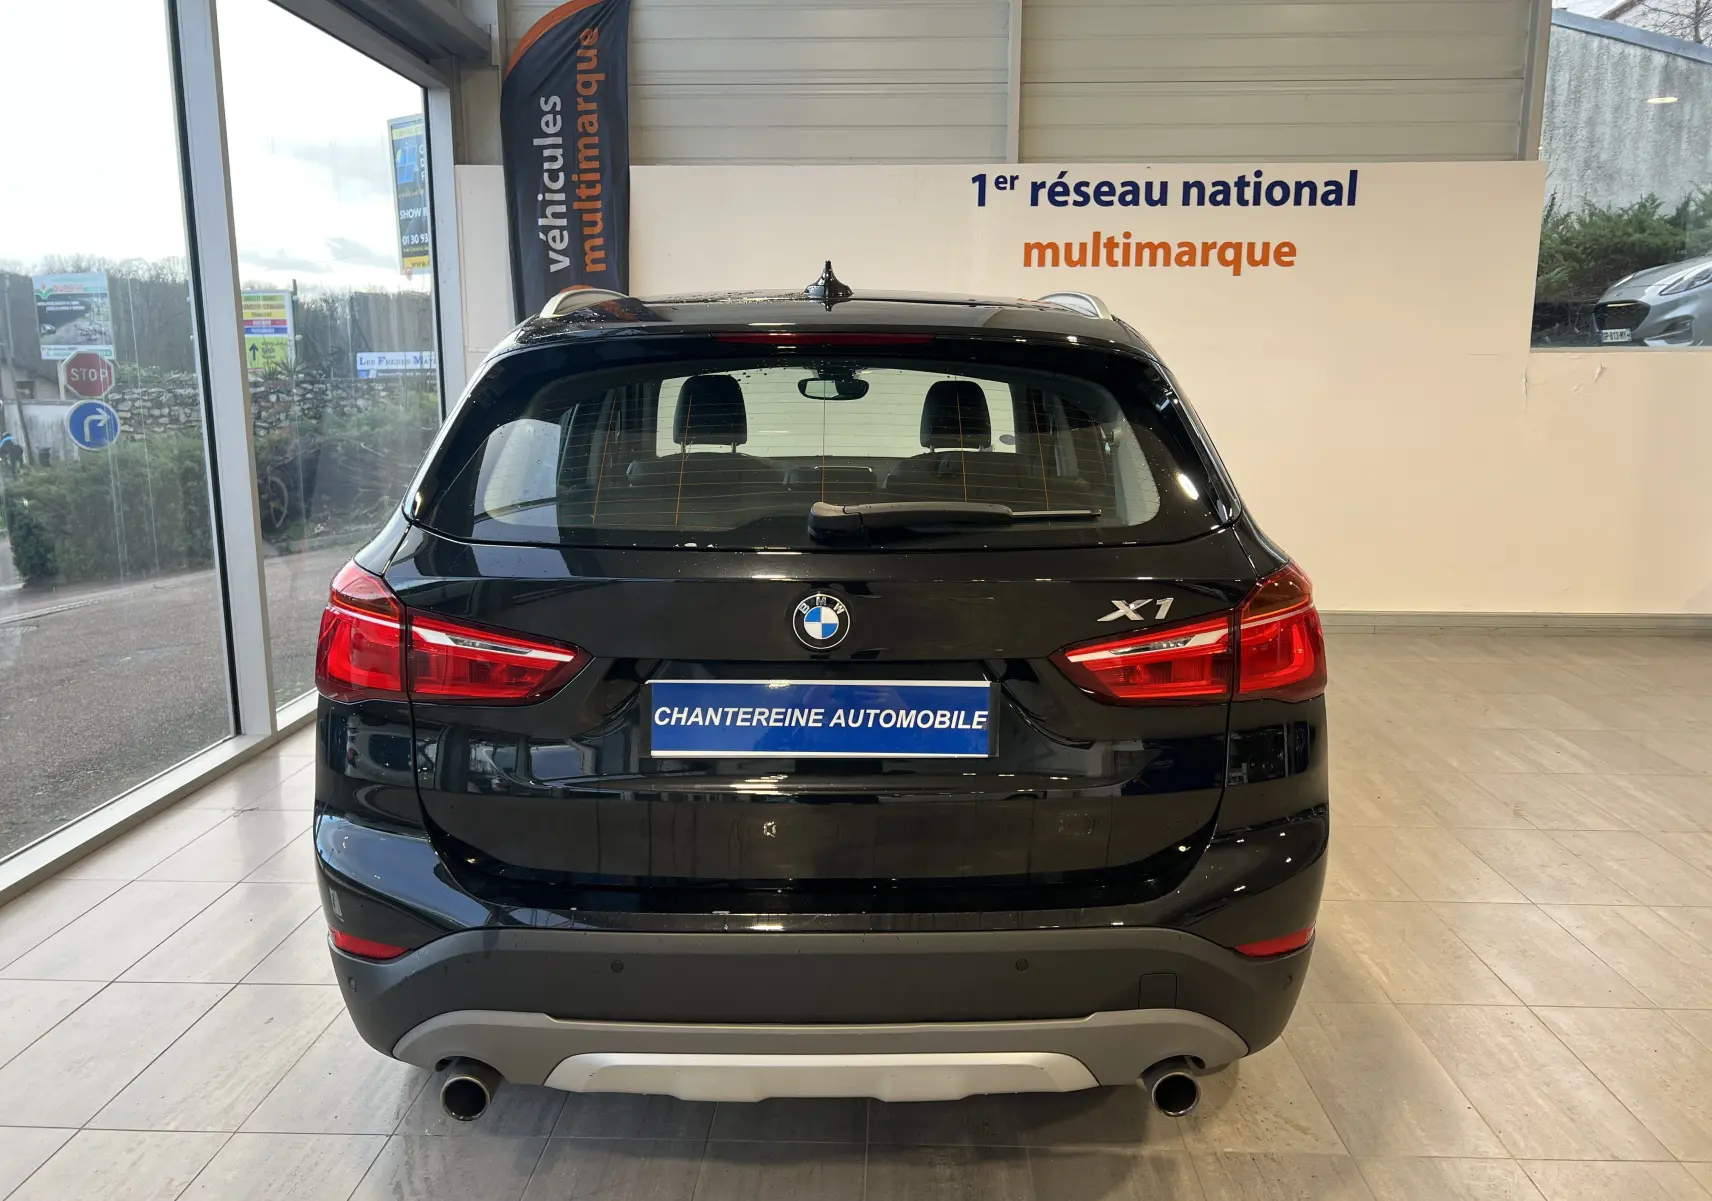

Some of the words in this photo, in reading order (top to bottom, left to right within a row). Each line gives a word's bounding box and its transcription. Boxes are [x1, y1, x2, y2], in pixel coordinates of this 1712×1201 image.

[573, 28, 606, 272] multimarque
[533, 95, 570, 272] véhicules
[1029, 171, 1168, 207] réseau
[1181, 169, 1358, 207] national
[400, 207, 421, 220] SHOW
[1023, 231, 1297, 276] multimarque
[70, 367, 108, 382] STOP
[798, 596, 845, 615] BMW
[1096, 597, 1174, 622] X1
[653, 706, 825, 728] CHANTEREINE
[829, 708, 988, 730] AUTOMOBILE
